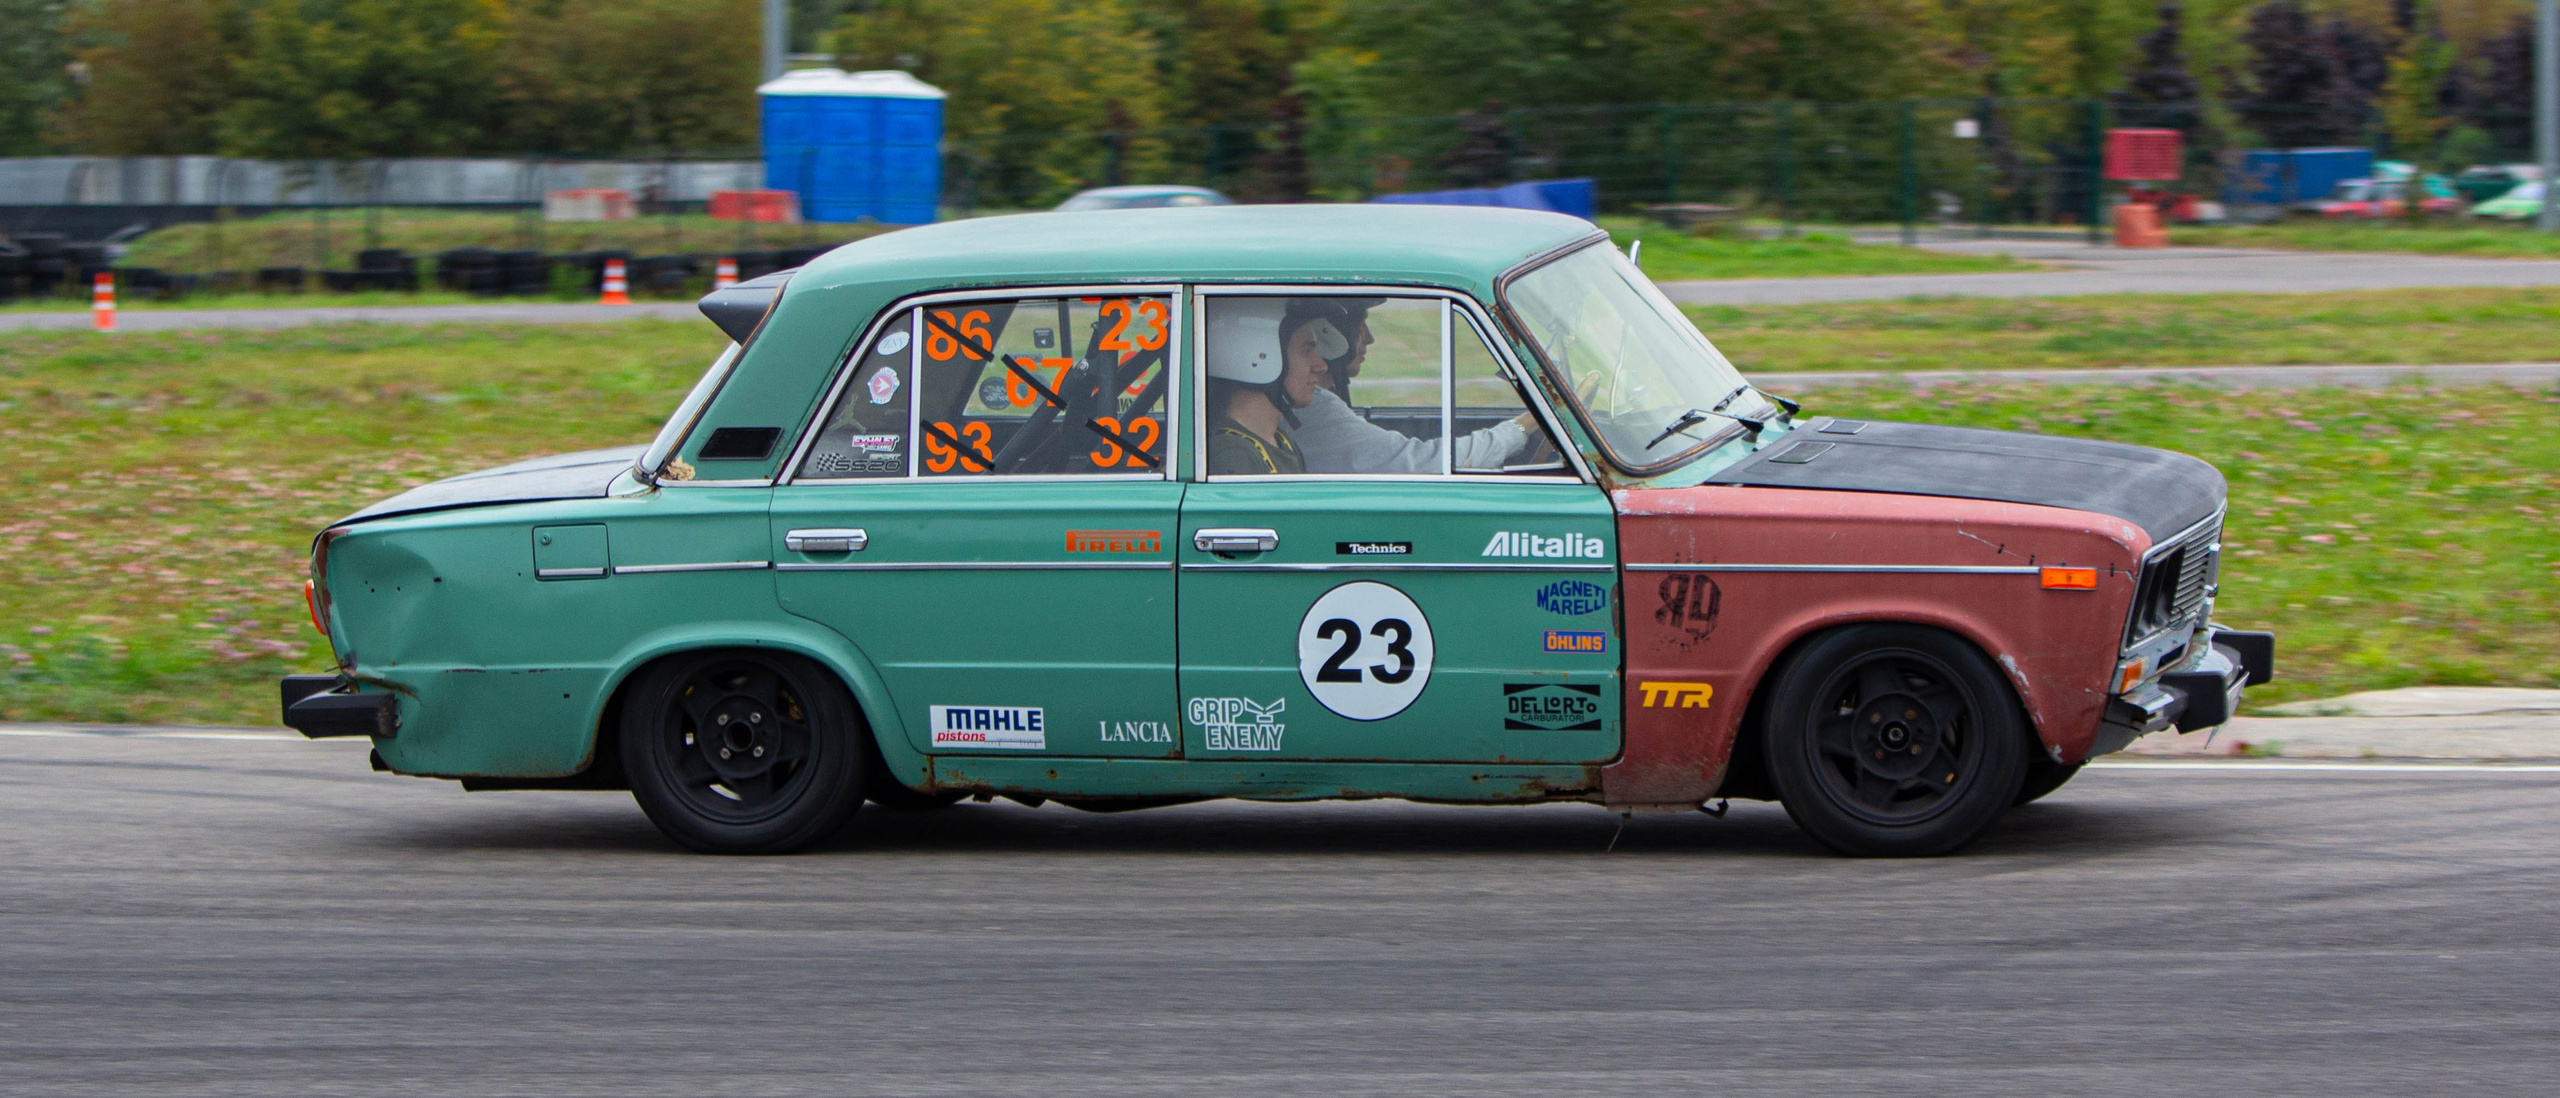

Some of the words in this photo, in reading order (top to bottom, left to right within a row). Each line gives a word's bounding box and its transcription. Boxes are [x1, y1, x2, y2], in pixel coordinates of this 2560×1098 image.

[926, 310, 993, 361] 86
[1098, 300, 1169, 351] 23
[1005, 357, 1074, 408] 67
[925, 421, 993, 473] 93
[1090, 417, 1161, 469] 32
[834, 460, 901, 472] SS20
[1065, 530, 1161, 552] PIRELLI
[1349, 543, 1406, 554] Technics
[1482, 531, 1604, 558] Alitalia
[1537, 580, 1606, 601] MAGNETI
[1537, 596, 1606, 615] MARELLI
[1315, 618, 1416, 684] 23
[1547, 631, 1603, 651] ÖHLINS
[1640, 682, 1713, 708] TTR
[946, 708, 1042, 731] MAHLE
[1188, 697, 1243, 725] GRIP
[1521, 714, 1585, 722] CARBURATORI
[936, 730, 986, 743] pistons
[1099, 721, 1172, 742] LANCIA
[1205, 724, 1285, 751] ENEMY
